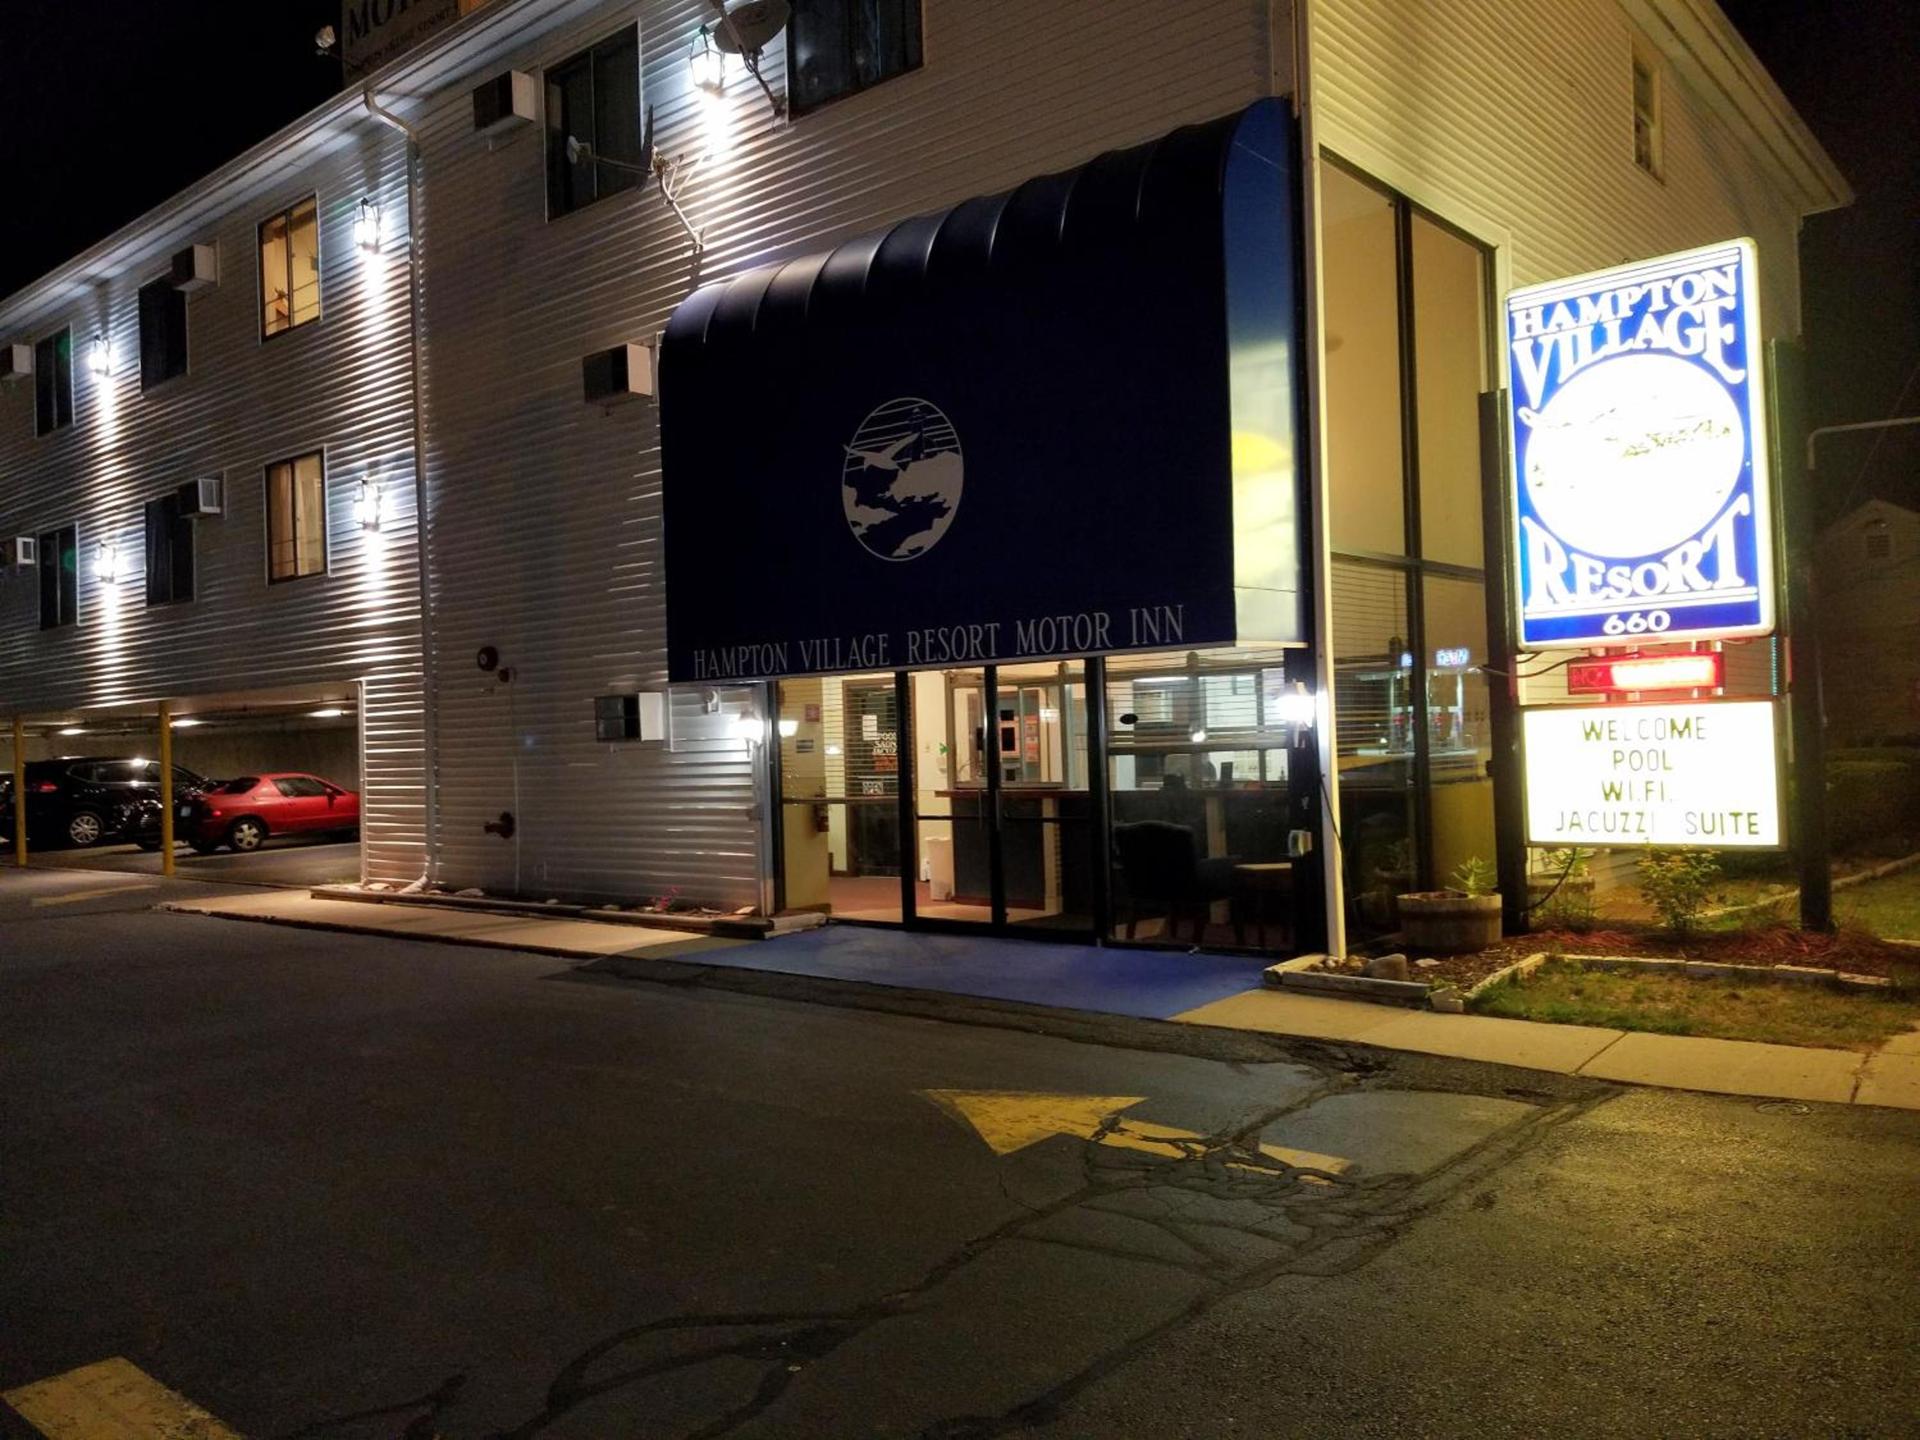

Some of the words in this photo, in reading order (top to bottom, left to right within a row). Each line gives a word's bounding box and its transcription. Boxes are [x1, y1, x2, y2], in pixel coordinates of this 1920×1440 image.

[1510, 264, 1739, 338] HAMPTON
[1511, 298, 1745, 409] VILLAGE
[1522, 493, 1750, 608] RESORT
[693, 641, 789, 680] HAMPTON
[799, 633, 890, 671] VILLAGE
[907, 622, 1000, 665] RESORT
[1015, 611, 1113, 656] MOTOR
[1129, 604, 1184, 646] INN
[1603, 610, 1671, 635] 660
[1582, 716, 1707, 742] WELCOME
[1612, 749, 1673, 772] POOL
[1555, 811, 1655, 834] JACUZZI
[1685, 811, 1760, 836] SUITE
